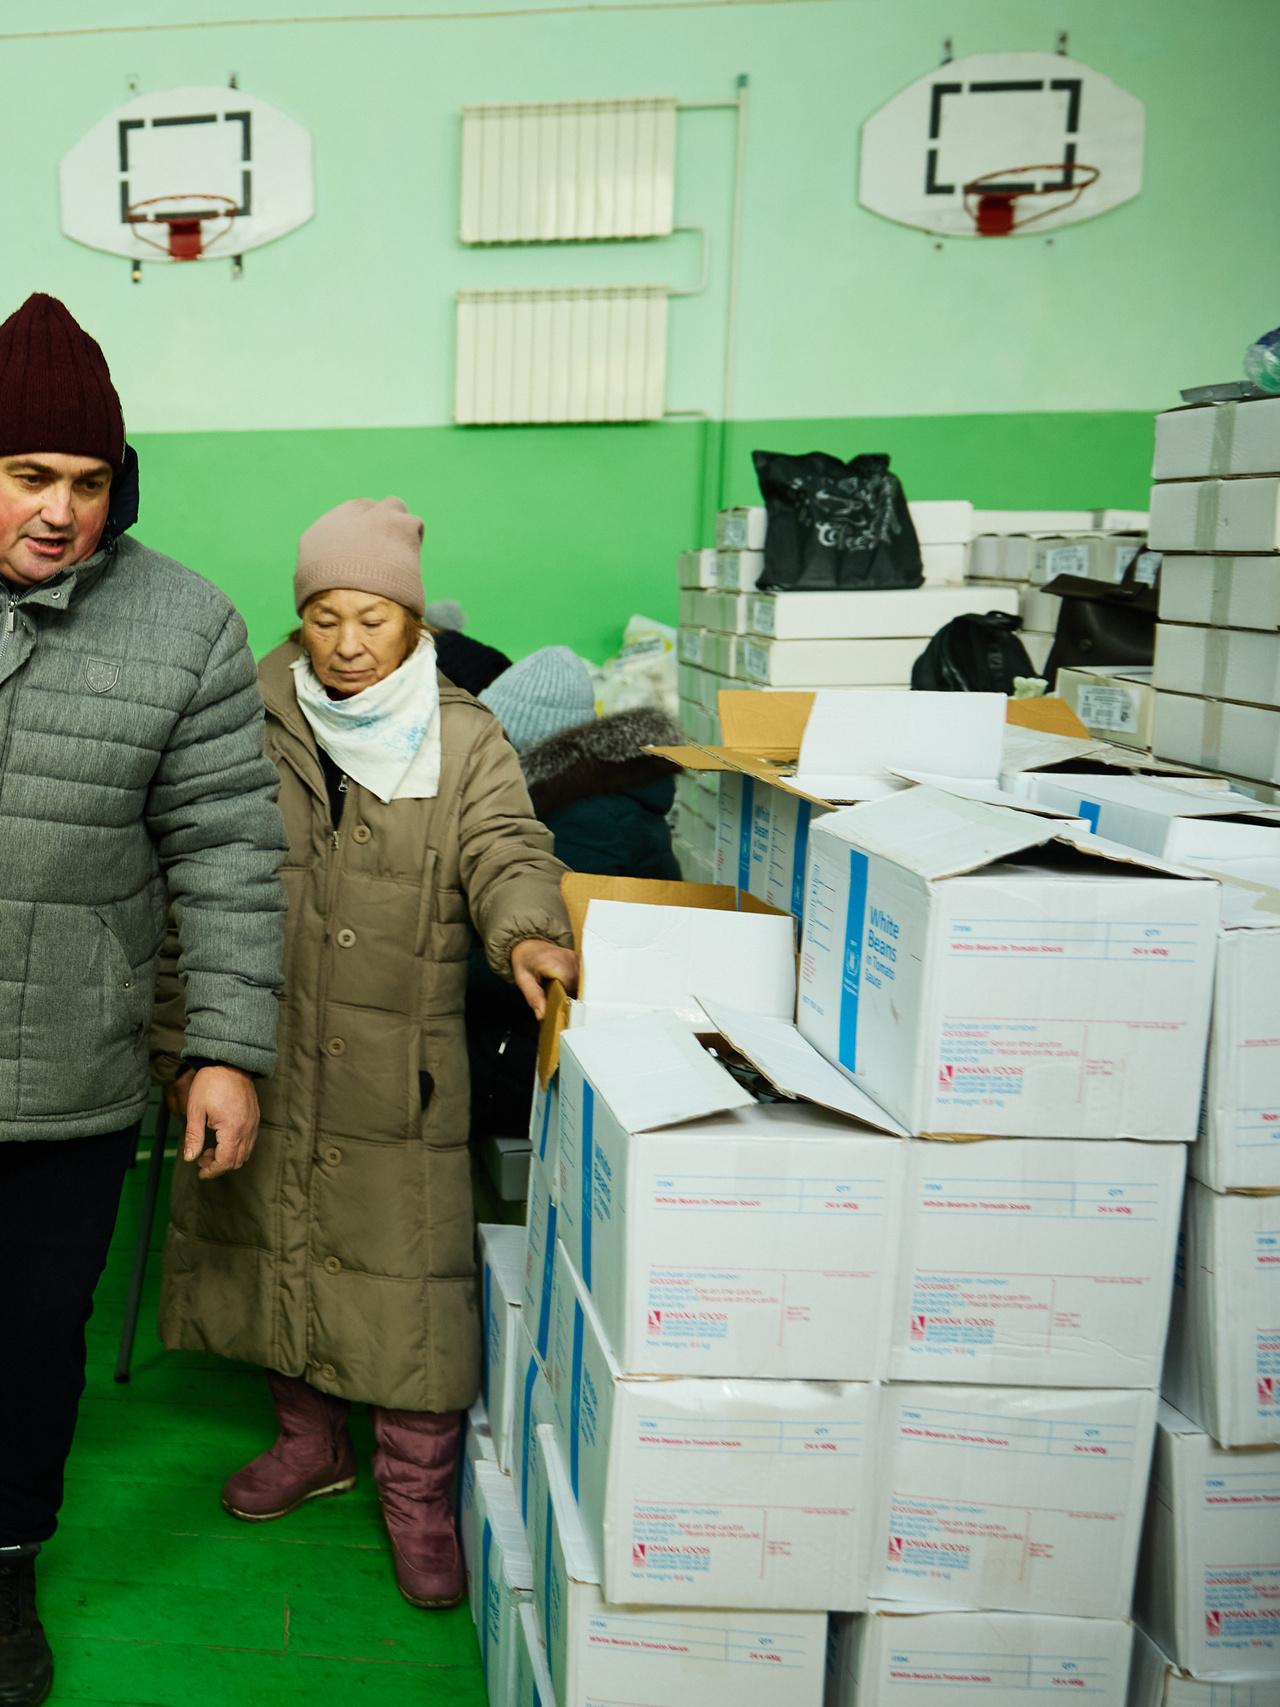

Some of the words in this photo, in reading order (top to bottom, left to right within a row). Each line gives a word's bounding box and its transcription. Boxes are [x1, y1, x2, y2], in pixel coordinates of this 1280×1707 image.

[870, 906, 899, 939] White
[868, 929, 896, 962] Beans
[865, 969, 882, 989] Sauce
[872, 955, 895, 981] Tomato
